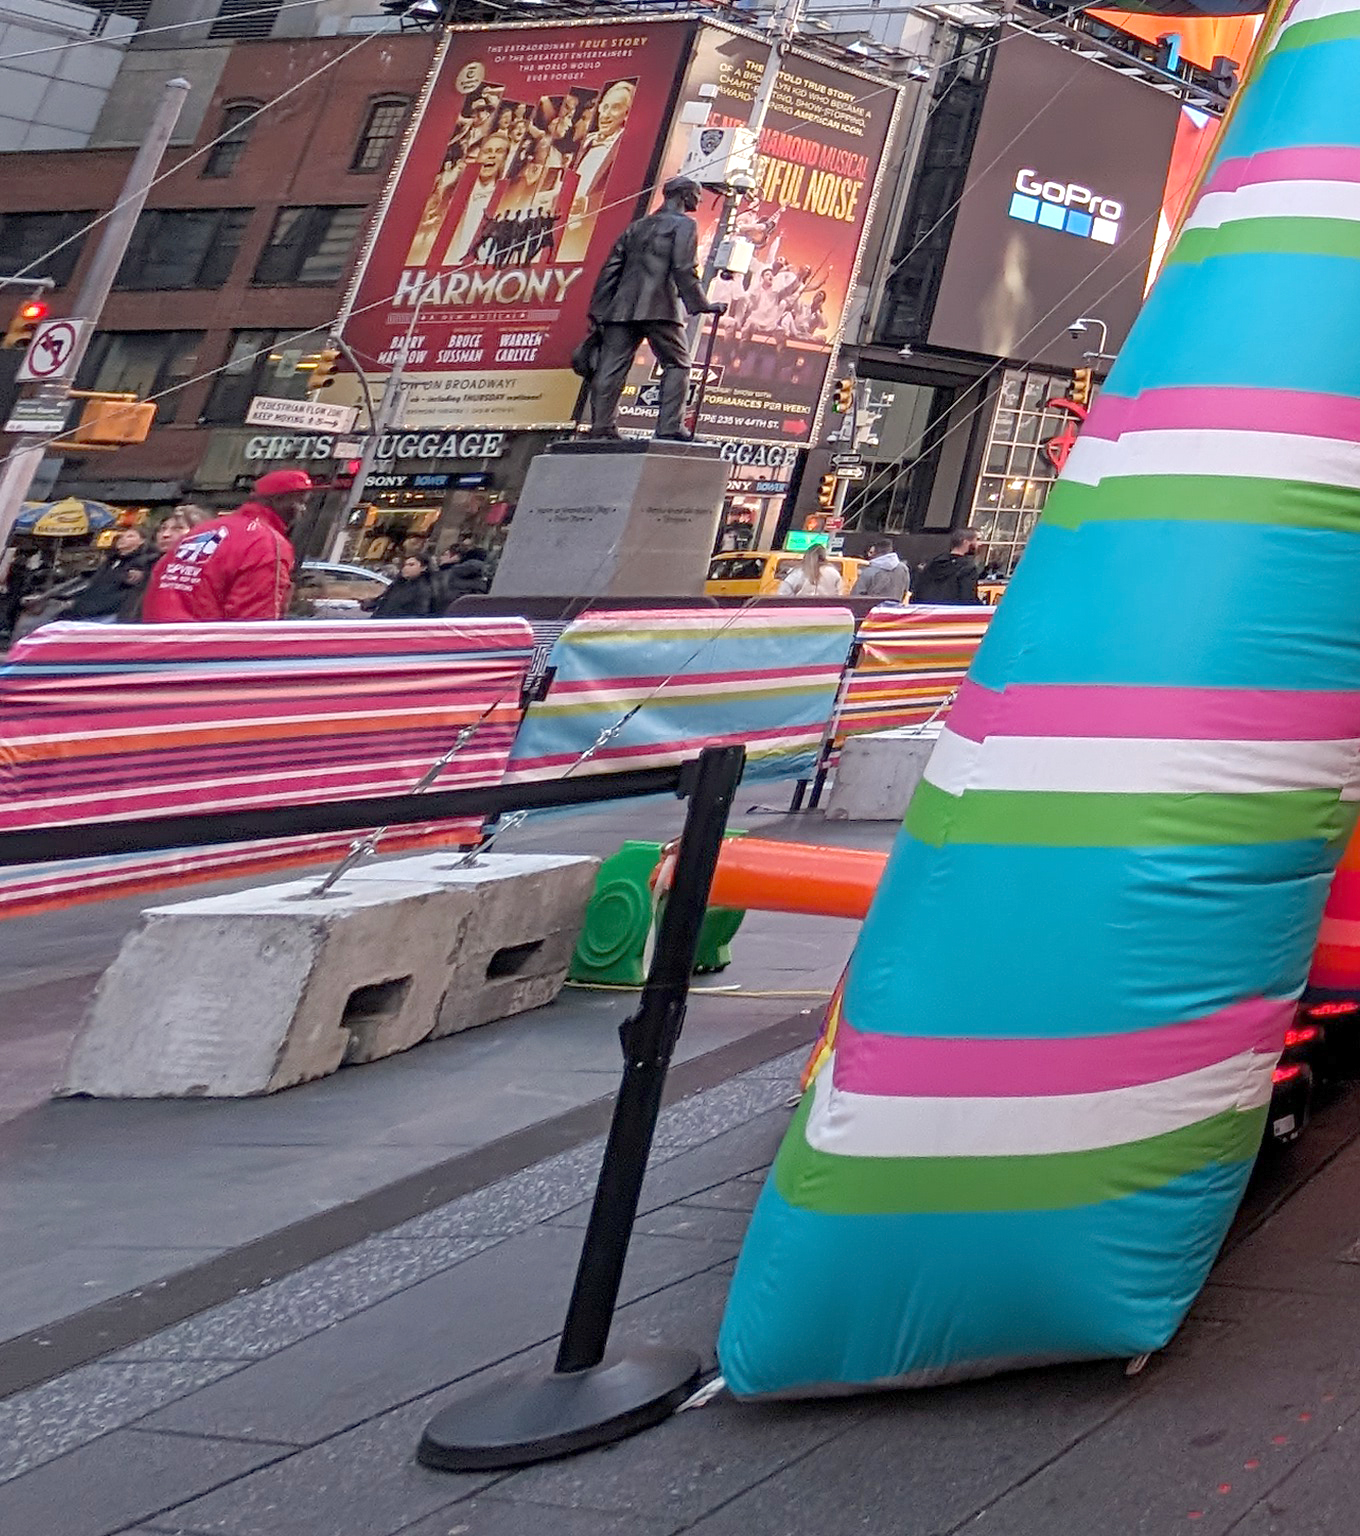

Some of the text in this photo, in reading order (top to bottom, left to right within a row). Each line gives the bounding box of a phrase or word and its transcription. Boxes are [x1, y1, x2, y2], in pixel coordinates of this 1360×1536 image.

[579, 39, 607, 49] TRUE
[610, 36, 649, 48] STORY
[733, 68, 742, 77] A
[864, 110, 872, 119] A
[803, 79, 827, 94] TRUE
[826, 87, 857, 102] STORY
[818, 144, 870, 181] MUSICAL
[802, 169, 865, 223] NOISE
[1015, 168, 1122, 221] GoPro
[391, 267, 584, 306] HARMONY
[390, 331, 543, 350] BARY BRUCE WARREN
[435, 349, 484, 364] SUSSMAN
[495, 348, 539, 363] CARLYLE
[245, 435, 334, 460] GIFTS
[364, 475, 408, 487] SONY
